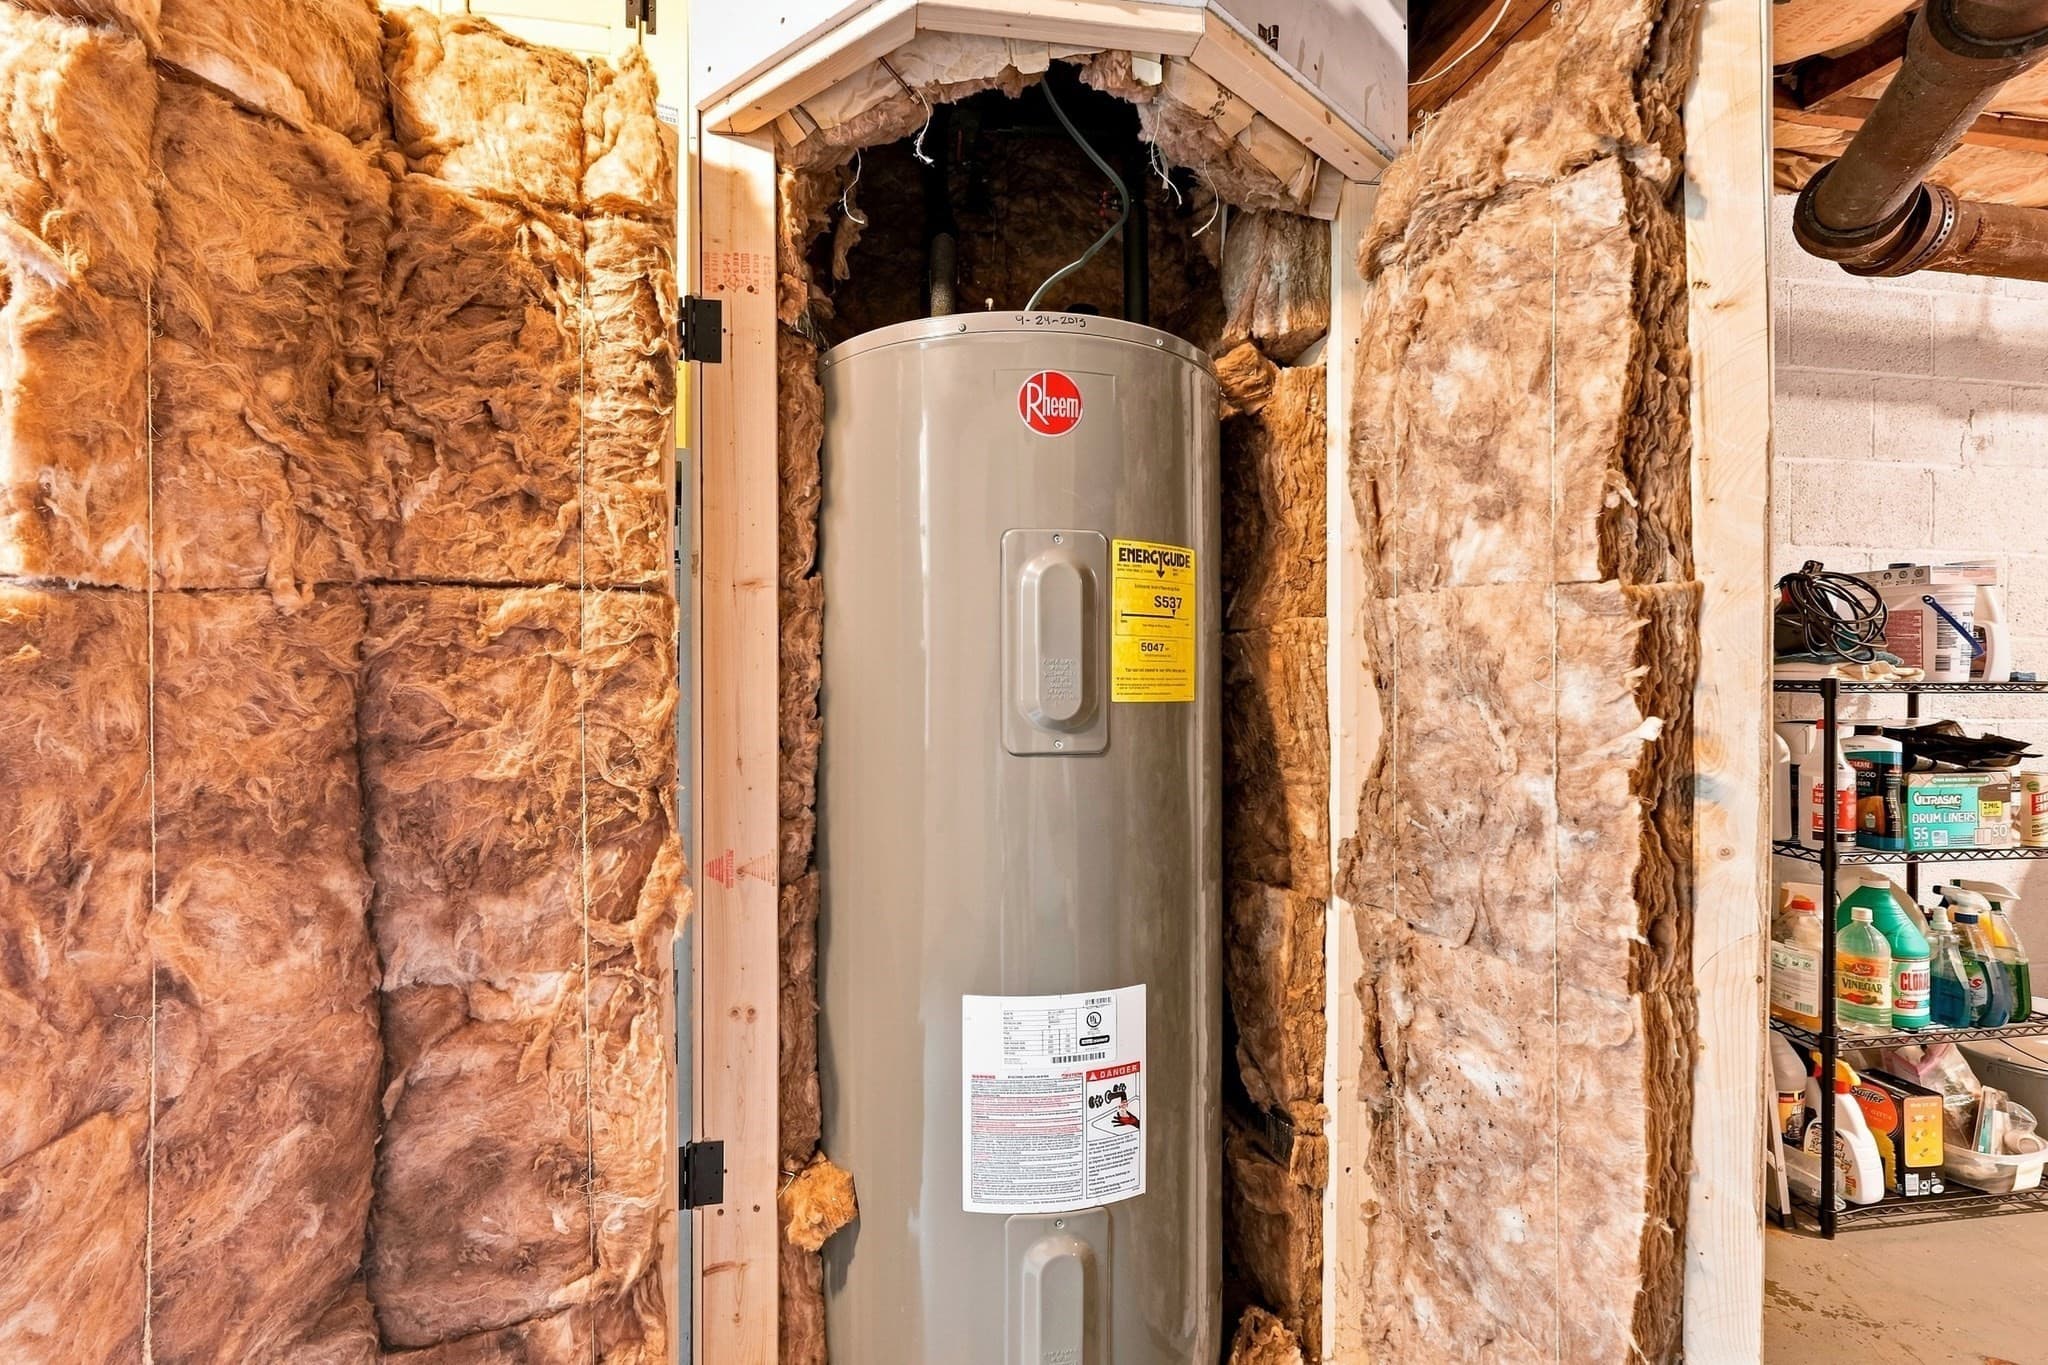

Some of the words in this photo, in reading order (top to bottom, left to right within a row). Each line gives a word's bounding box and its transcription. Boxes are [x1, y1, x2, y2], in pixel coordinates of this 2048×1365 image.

[1026, 372, 1079, 426] Rheem
[1140, 642, 1165, 652] 5047
[1912, 812, 1942, 824] DRUM
[1943, 811, 1977, 823] LINERS
[1841, 977, 1883, 994] VINEGAR
[1099, 1064, 1138, 1078] DANGER
[1850, 1085, 1885, 1103] Swiffer
